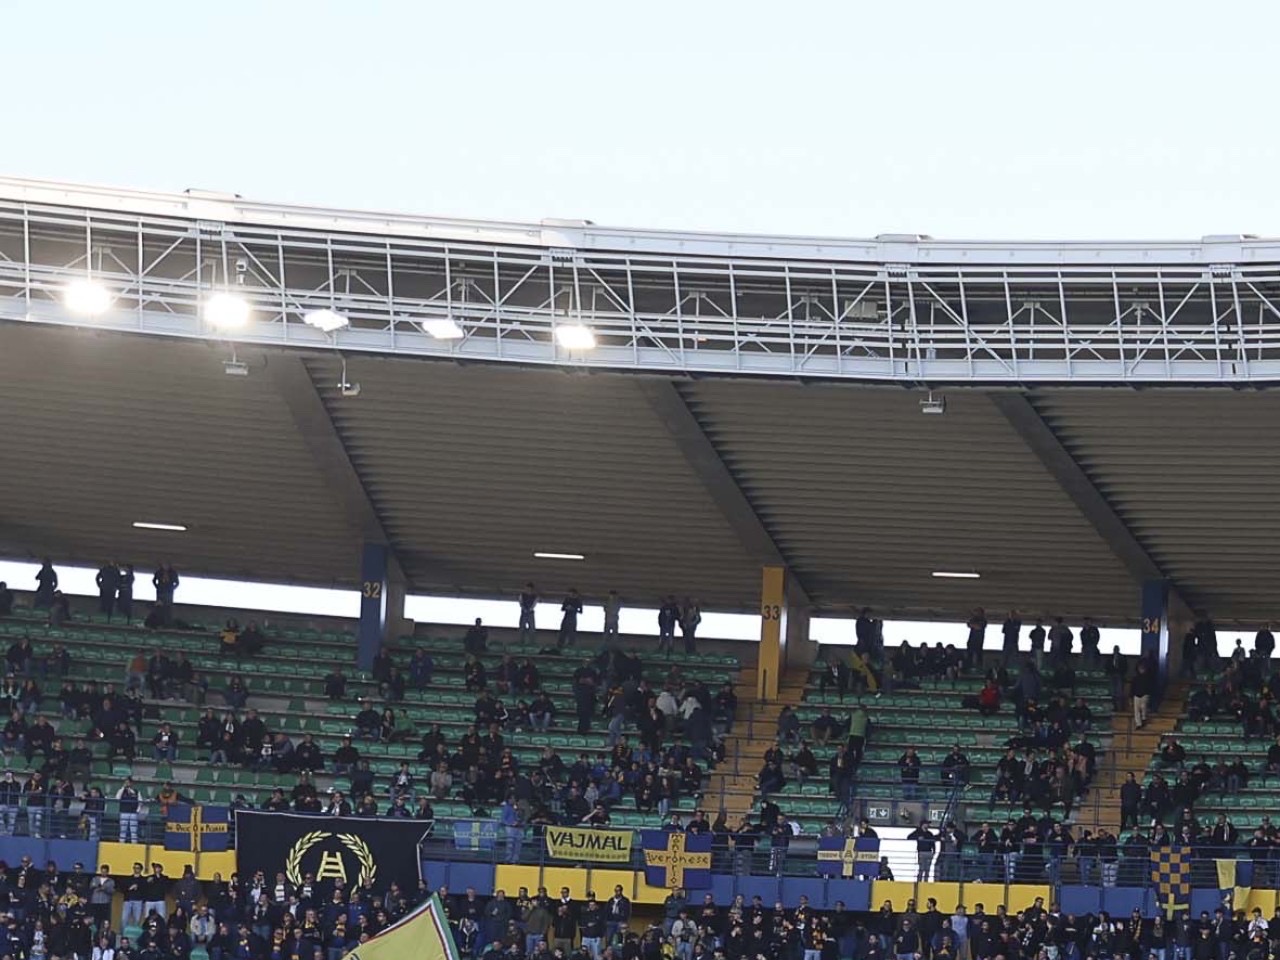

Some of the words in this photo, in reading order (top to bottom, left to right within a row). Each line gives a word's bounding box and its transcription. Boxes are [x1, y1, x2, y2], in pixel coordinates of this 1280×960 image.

[364, 582, 380, 598] 32
[763, 605, 780, 620] 33
[1143, 618, 1159, 633] 34
[549, 830, 629, 850] VAJMAL
